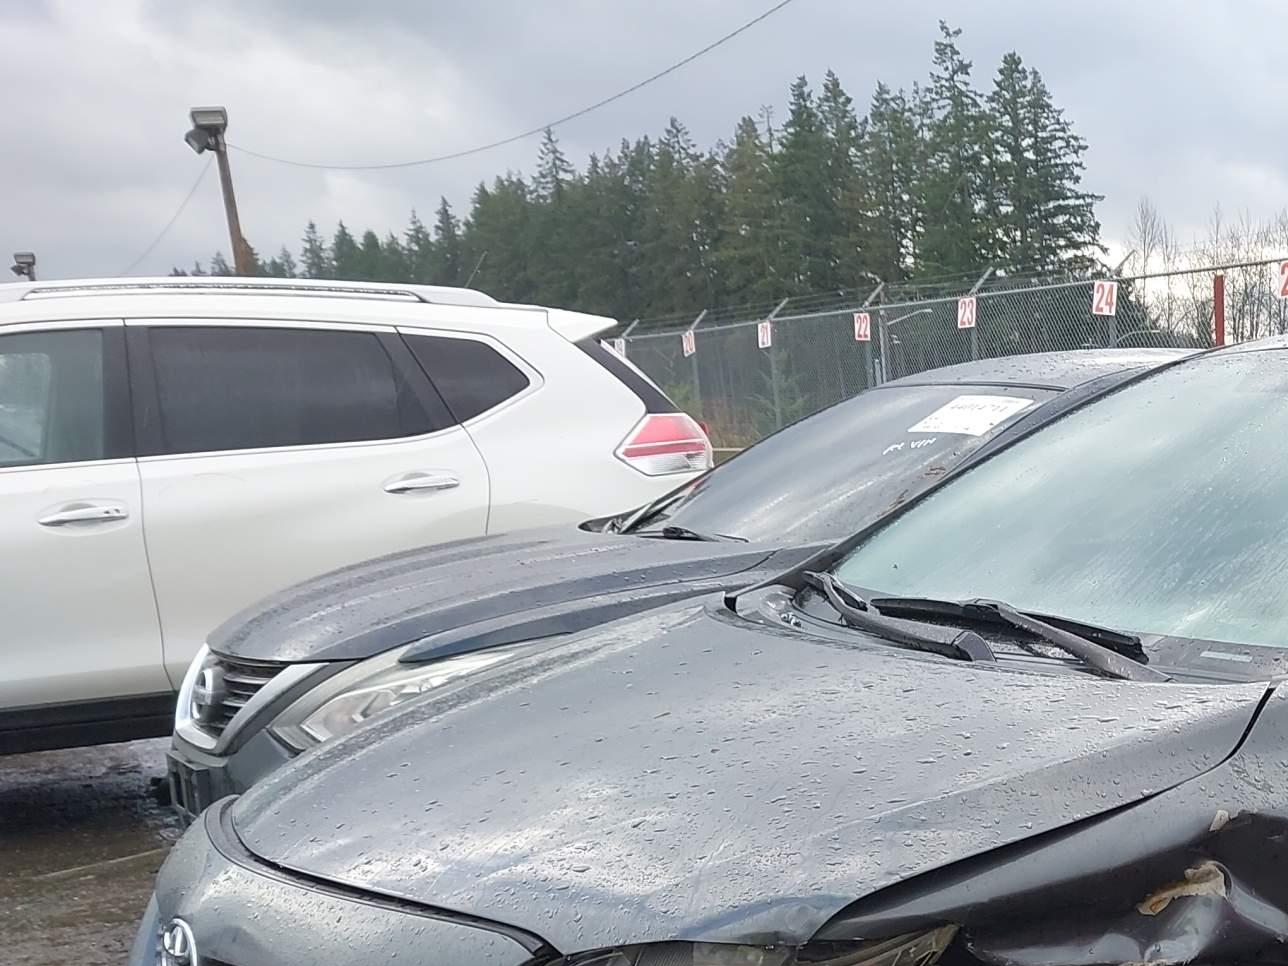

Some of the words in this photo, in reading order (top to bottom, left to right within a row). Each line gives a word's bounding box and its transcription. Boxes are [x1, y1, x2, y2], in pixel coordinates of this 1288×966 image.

[1094, 283, 1115, 314] 24
[856, 314, 869, 339] 22
[959, 299, 974, 327] 23
